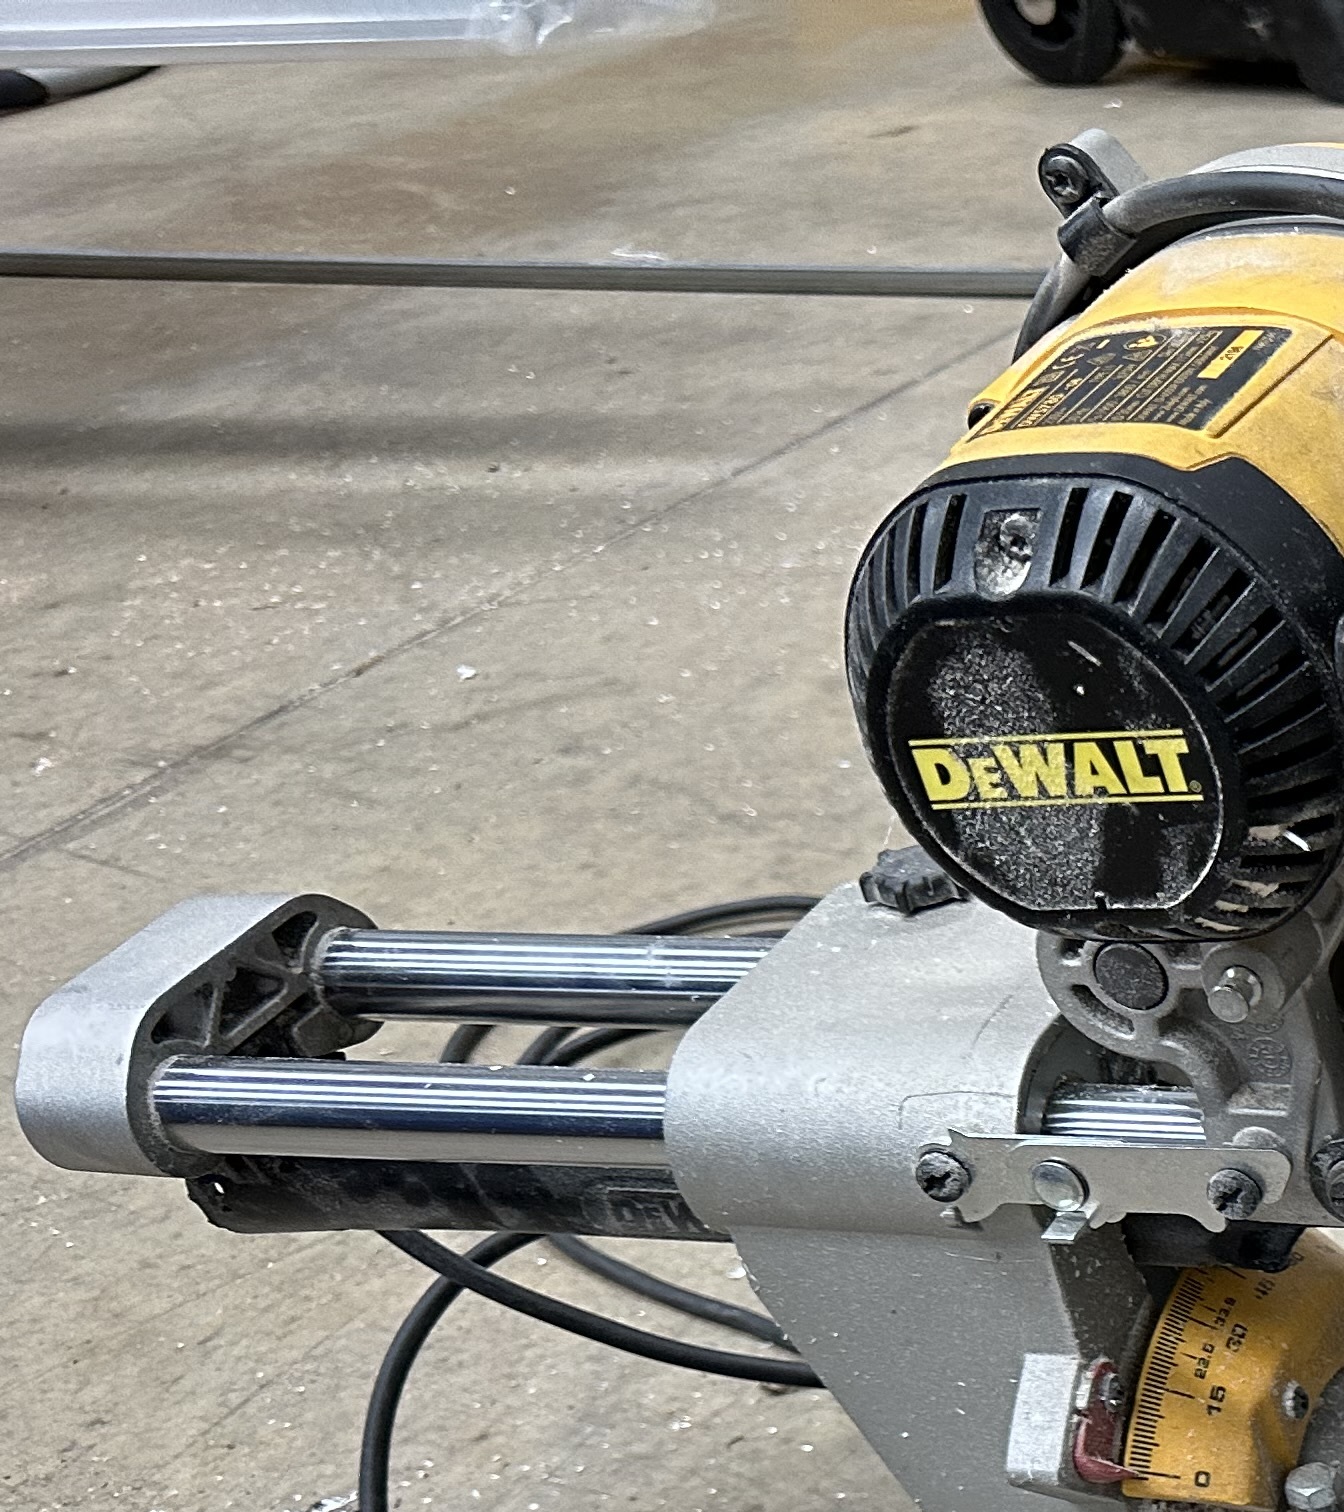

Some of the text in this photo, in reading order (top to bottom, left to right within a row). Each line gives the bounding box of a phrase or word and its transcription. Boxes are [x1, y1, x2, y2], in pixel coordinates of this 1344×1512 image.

[912, 738, 1189, 802] DEWALT
[1226, 1323, 1248, 1352] 30
[1207, 1385, 1227, 1416] 15
[1194, 1471, 1211, 1488] 0
